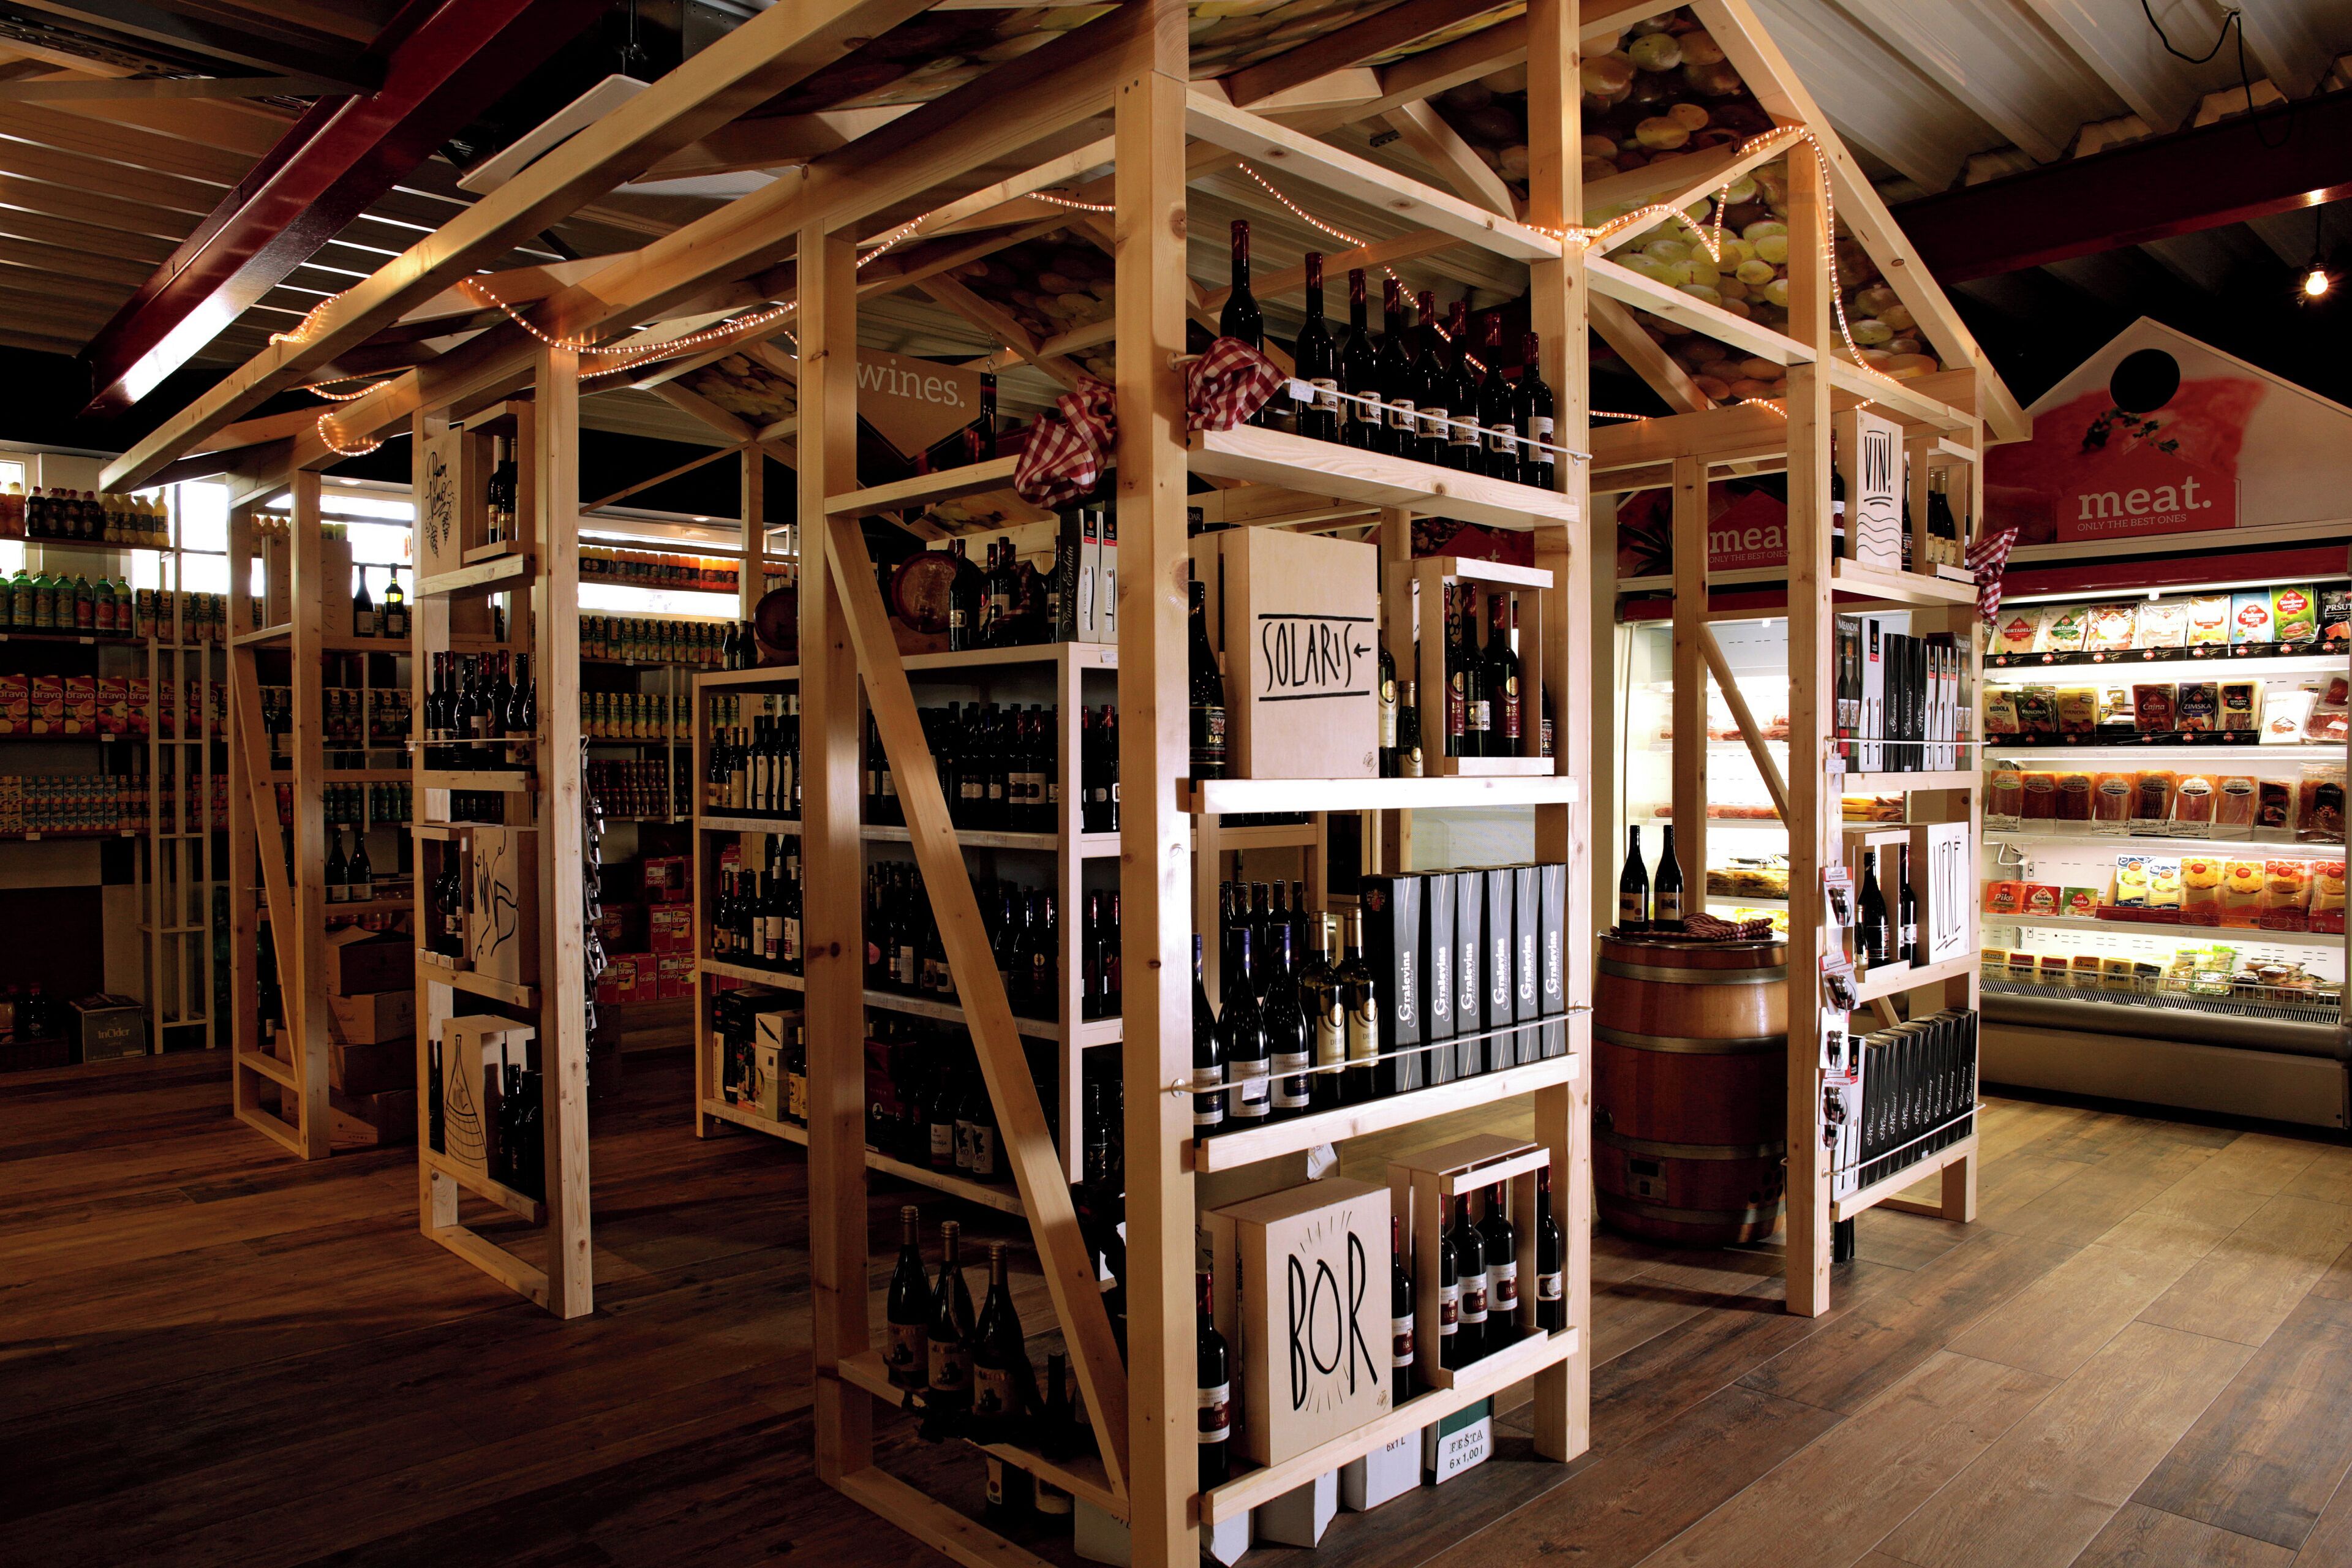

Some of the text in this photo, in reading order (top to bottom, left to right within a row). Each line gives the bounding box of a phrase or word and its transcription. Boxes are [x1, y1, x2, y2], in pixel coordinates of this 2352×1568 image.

[858, 359, 965, 409] wines.
[1864, 432, 1891, 493] VIN!
[2078, 476, 2212, 520] meat.
[1709, 525, 1787, 554] mea
[2077, 514, 2187, 532] ONLY THE BEST ONES
[1730, 553, 1746, 562] THE
[1747, 552, 1766, 560] BEST
[1262, 622, 1352, 693] SOLARIS
[34, 690, 62, 699] bravo
[66, 690, 94, 699] bravo
[98, 690, 126, 699] bravo
[129, 690, 149, 699] brav
[161, 690, 175, 699] bra
[1994, 893, 2014, 902] Piko
[1434, 946, 1448, 1017] Graševina
[1461, 943, 1475, 1014] Graševina
[1493, 938, 1506, 1006] Graševina
[1520, 935, 1534, 1005] Graševina
[1545, 930, 1559, 999] Graševina
[1398, 951, 1412, 1022] Graševina
[1288, 1231, 1378, 1411] BOR
[1449, 1429, 1483, 1454] FEŠTA
[1449, 1460, 1455, 1469] 6
[1456, 1457, 1461, 1466] x
[1463, 1447, 1479, 1463] 1,00
